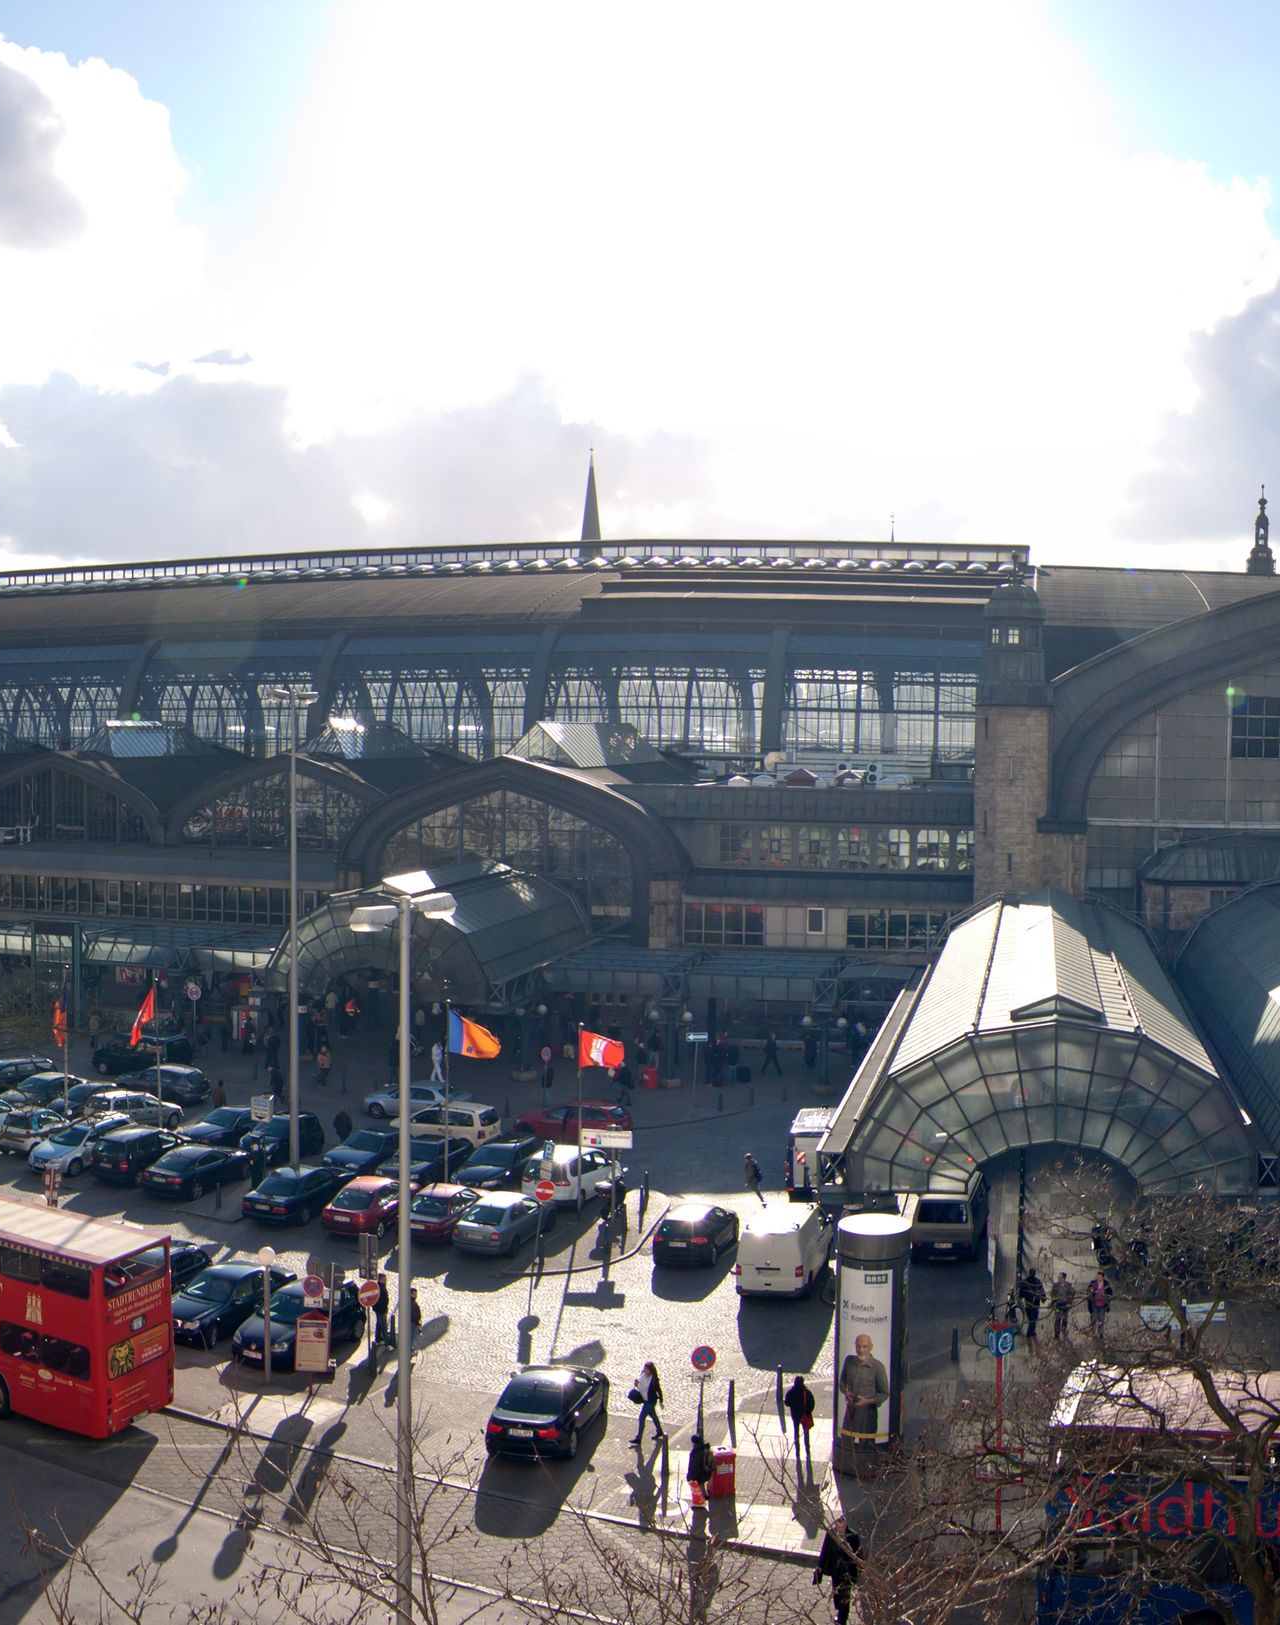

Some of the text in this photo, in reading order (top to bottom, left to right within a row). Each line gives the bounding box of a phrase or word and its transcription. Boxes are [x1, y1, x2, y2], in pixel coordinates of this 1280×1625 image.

[866, 1276, 887, 1284] BASE
[107, 1277, 166, 1311] STADTRUNDFAHRT
[851, 1303, 875, 1312] Einfach
[850, 1314, 888, 1324] Kompliziert
